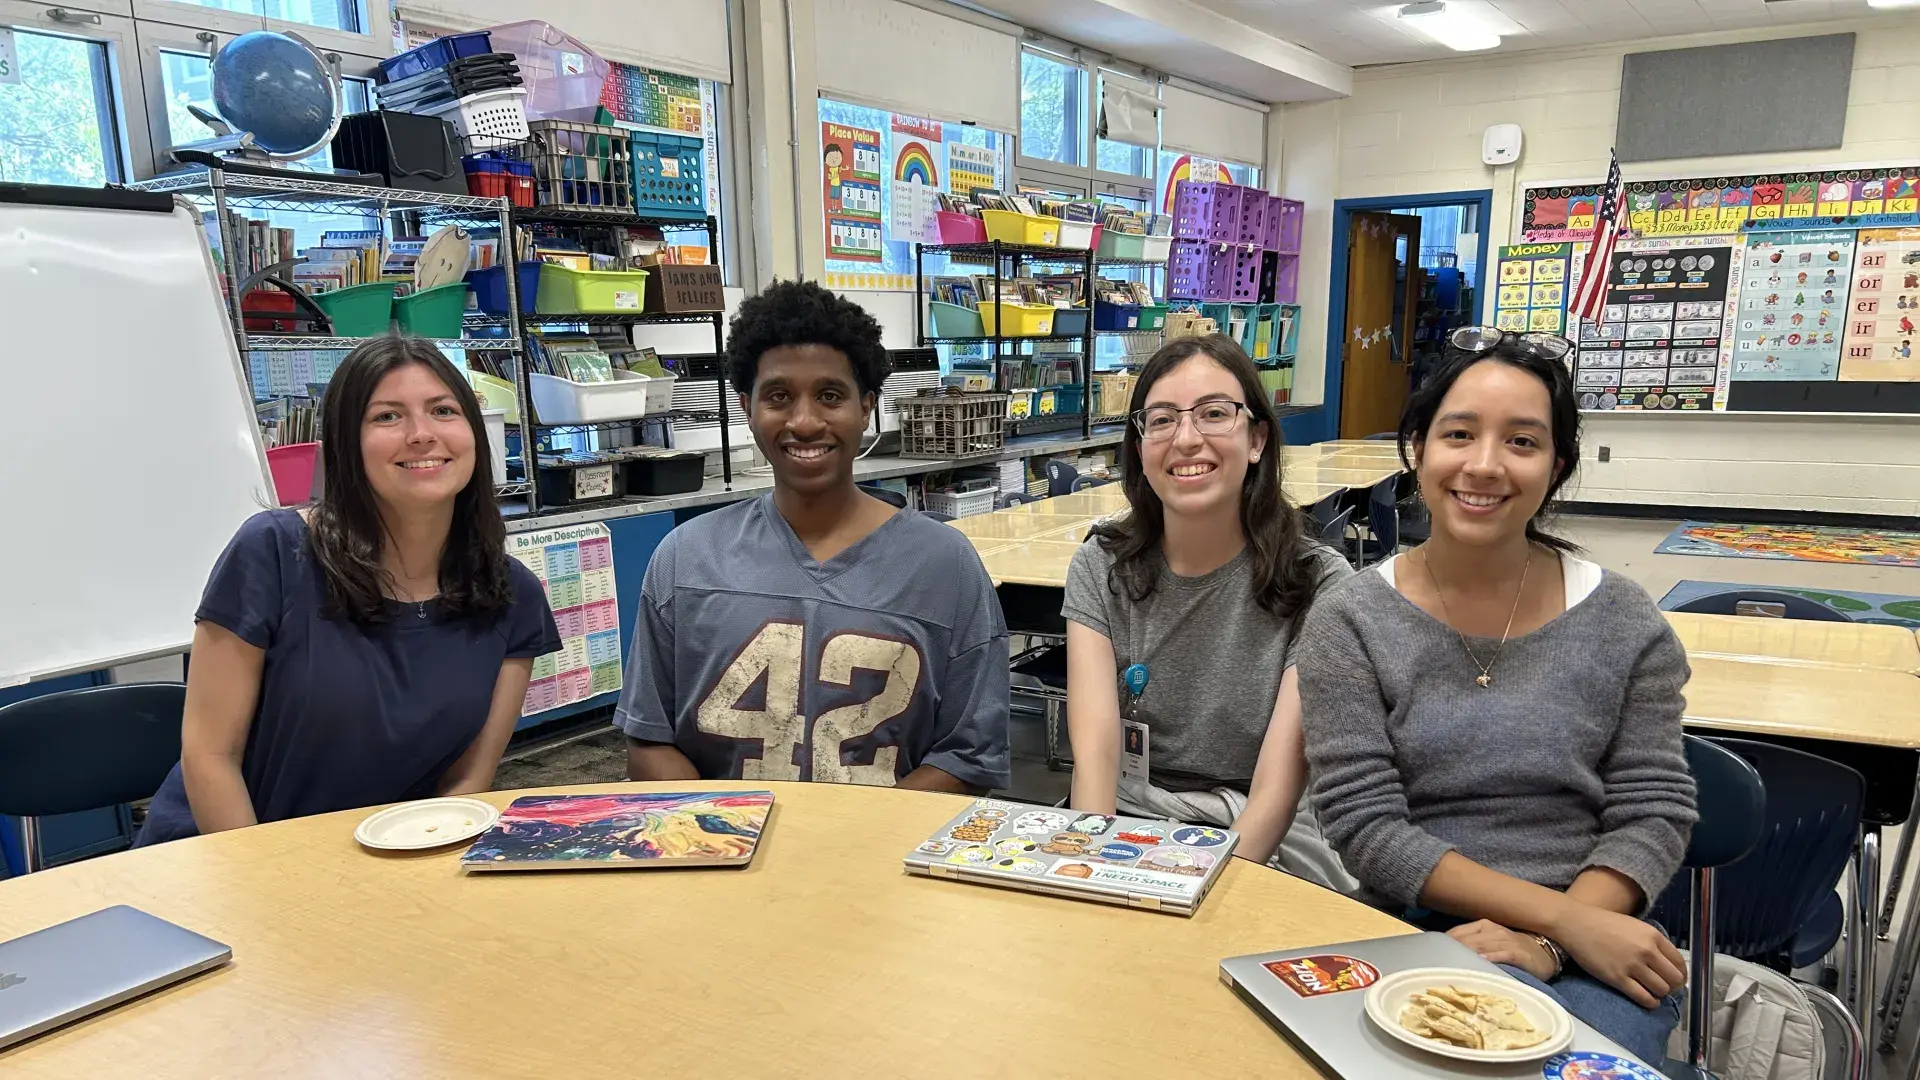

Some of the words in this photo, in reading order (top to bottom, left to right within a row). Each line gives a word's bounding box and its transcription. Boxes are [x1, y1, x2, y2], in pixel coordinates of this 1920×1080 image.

[829, 125, 851, 139] Place
[853, 130, 874, 143] Value
[1572, 217, 1590, 227] Aa
[1633, 212, 1649, 224] Cc
[1662, 211, 1680, 222] Dd
[1696, 209, 1710, 220] Ee
[1727, 207, 1740, 219] Ff
[1756, 206, 1775, 218] Gg
[1789, 205, 1808, 216] Hh
[1830, 204, 1838, 214] Ii
[1892, 198, 1910, 211] Kk
[1666, 222, 1693, 233] Money
[1766, 219, 1794, 228] Vowel
[1800, 217, 1830, 226] Sounds
[1533, 230, 1554, 239] Pledge
[1508, 244, 1562, 256] Money
[1863, 255, 1883, 266] ar
[1730, 267, 1740, 298] sunshie
[1860, 278, 1881, 289] or
[677, 290, 716, 304] JELLIES
[1727, 302, 1735, 317] helo
[1749, 300, 1753, 308] i
[1858, 301, 1877, 311] er
[1745, 320, 1752, 329] o
[1857, 323, 1870, 334] ir
[1723, 318, 1733, 349] sunshie
[1742, 341, 1750, 350] u
[1850, 347, 1871, 357] ur
[1721, 354, 1729, 369] helo
[1740, 362, 1747, 372] y
[1717, 371, 1727, 400] sunshie
[580, 469, 610, 481] Classroom
[517, 537, 529, 547] Be
[532, 534, 552, 544] More
[555, 527, 600, 540] Descriptive
[696, 620, 921, 786] 42
[1101, 873, 1138, 882] NEED
[1140, 879, 1187, 888] SPACE
[1289, 963, 1328, 991] ZION
